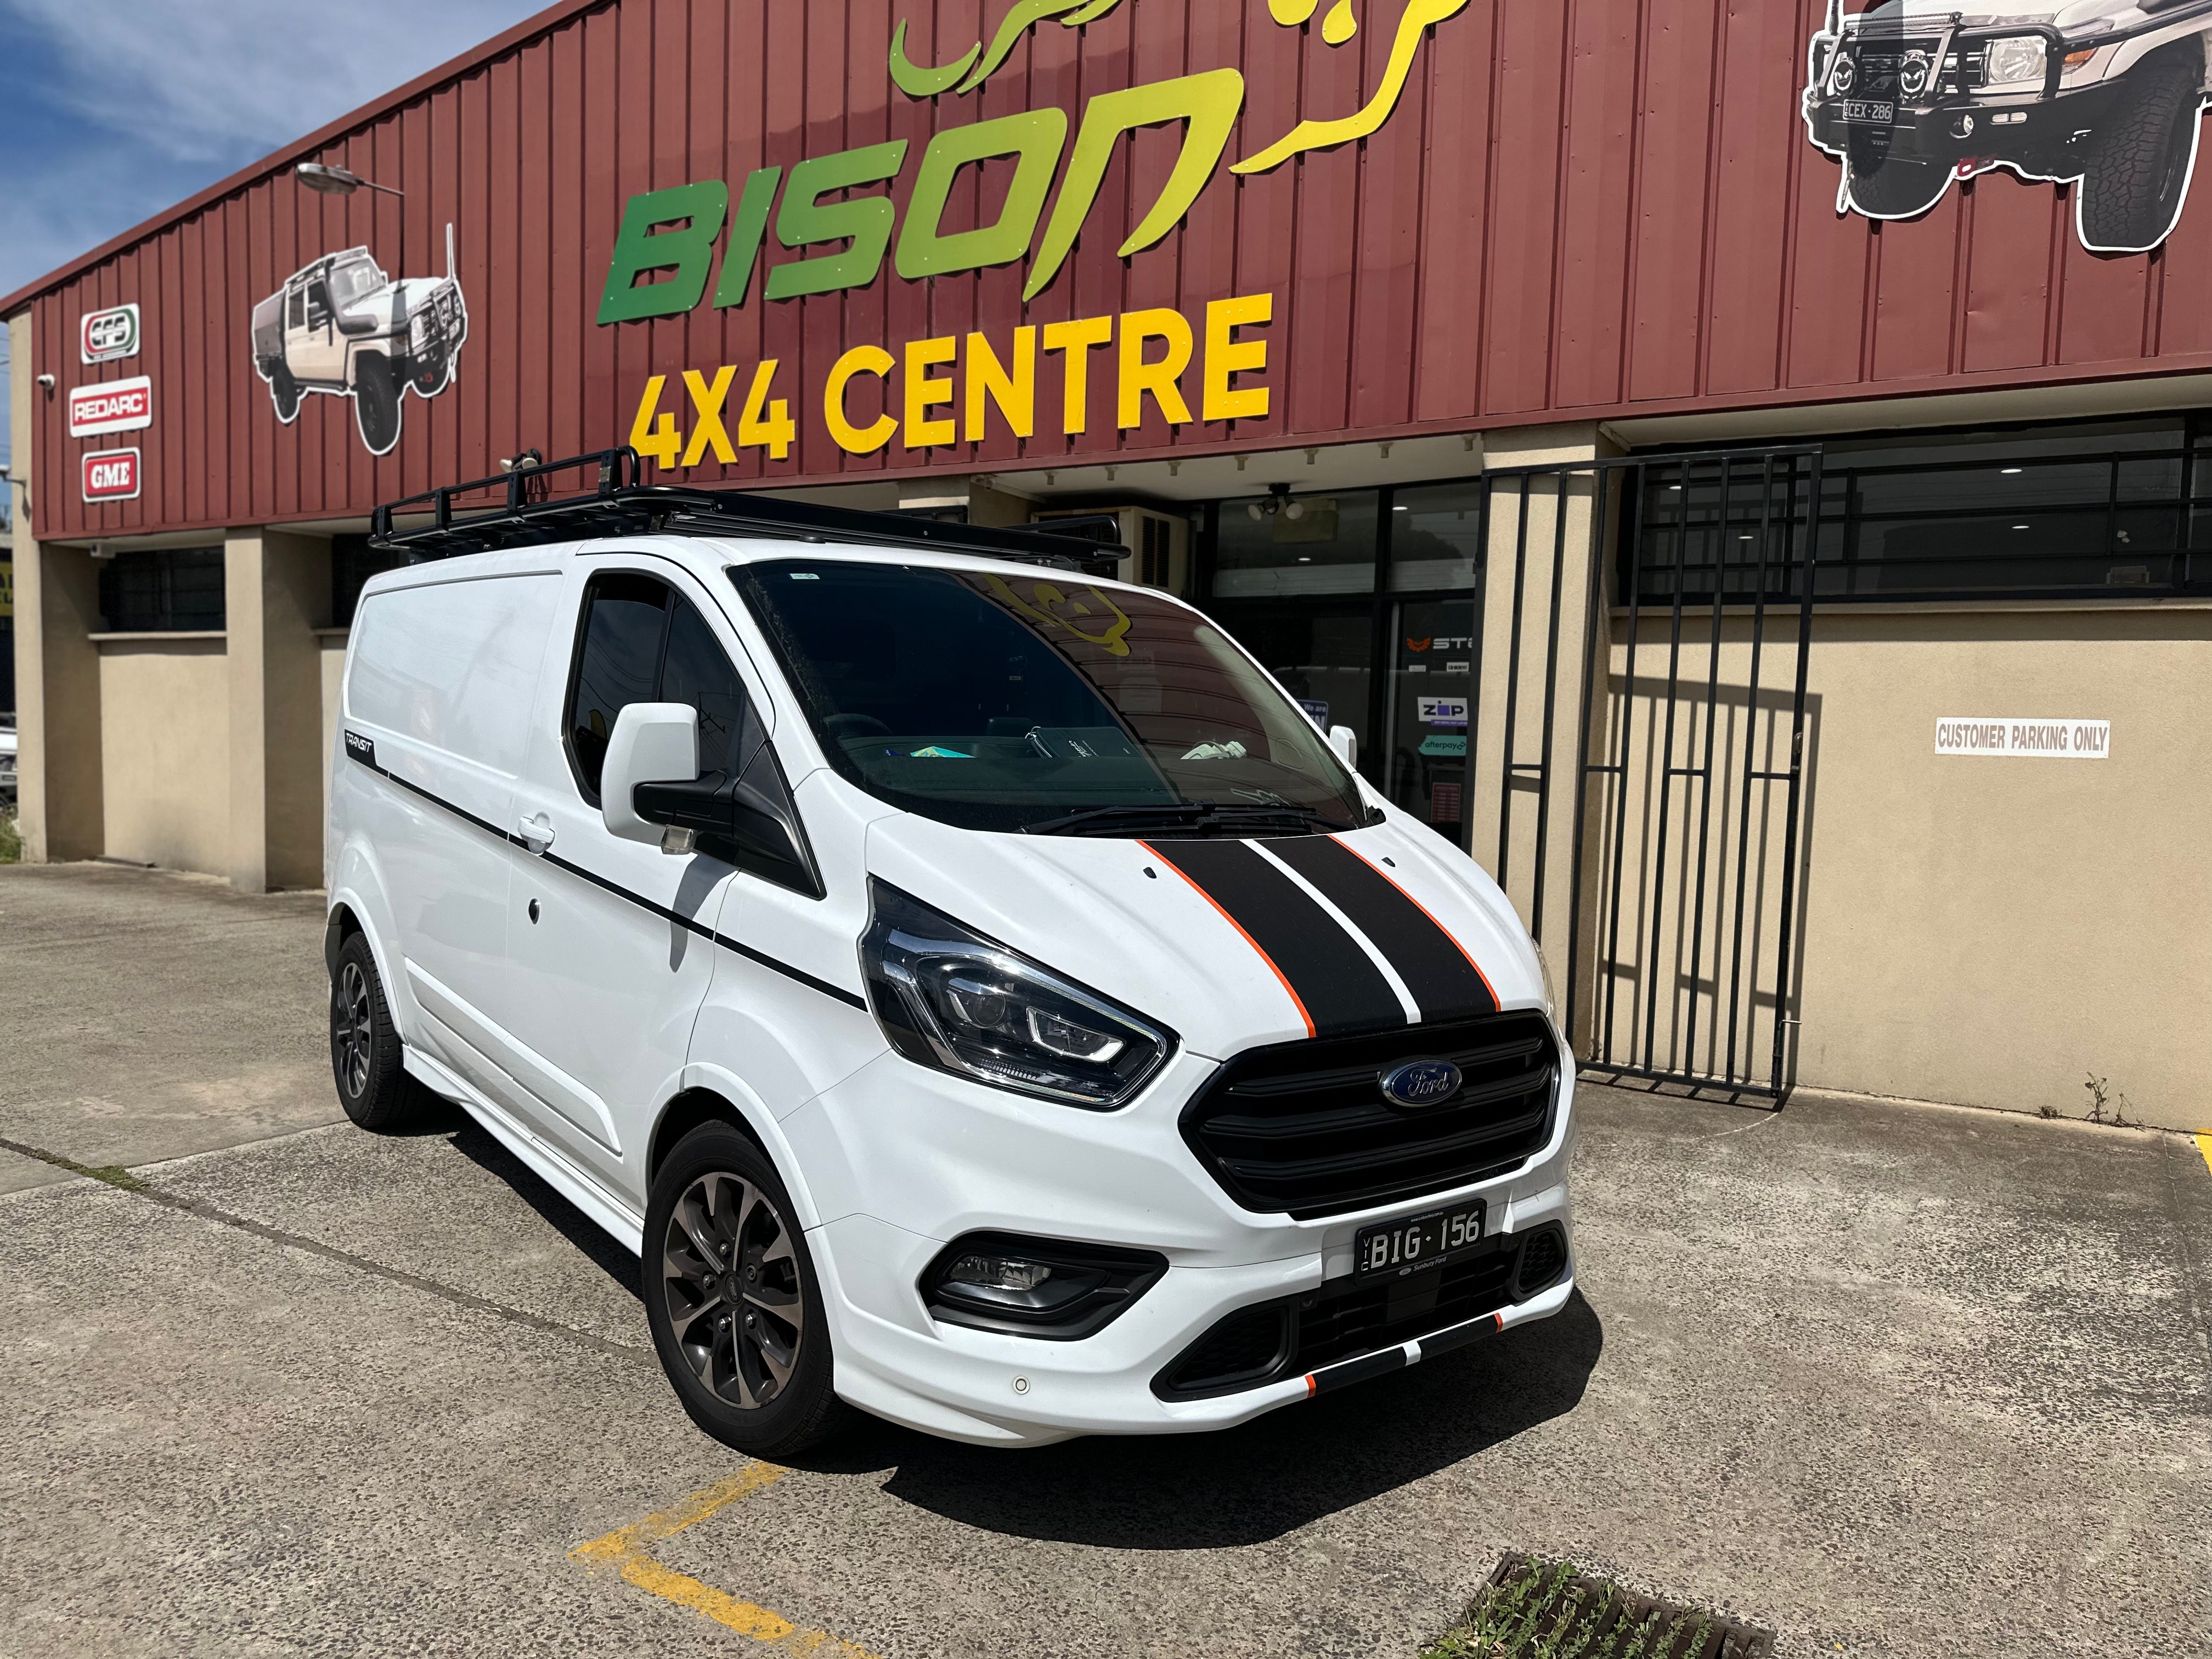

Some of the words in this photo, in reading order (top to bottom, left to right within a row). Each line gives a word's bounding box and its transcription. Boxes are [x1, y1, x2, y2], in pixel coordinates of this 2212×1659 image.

[596, 68, 1244, 325] BISON
[630, 359, 795, 470] 4X4
[825, 293, 1273, 453] CENTRE
[74, 393, 143, 421] REDARC
[91, 462, 130, 489] GME
[1304, 703, 1314, 712] We
[346, 732, 372, 753] TRANSIT
[1425, 741, 1457, 750] afterpay
[1938, 723, 2005, 748] CUSTOMER
[2012, 725, 2068, 751] PARKING
[2074, 726, 2108, 751] ONLY
[1408, 1068, 1449, 1097] Ford
[1414, 1261, 1435, 1271] Sunbury
[1435, 1256, 1447, 1265] Ford
